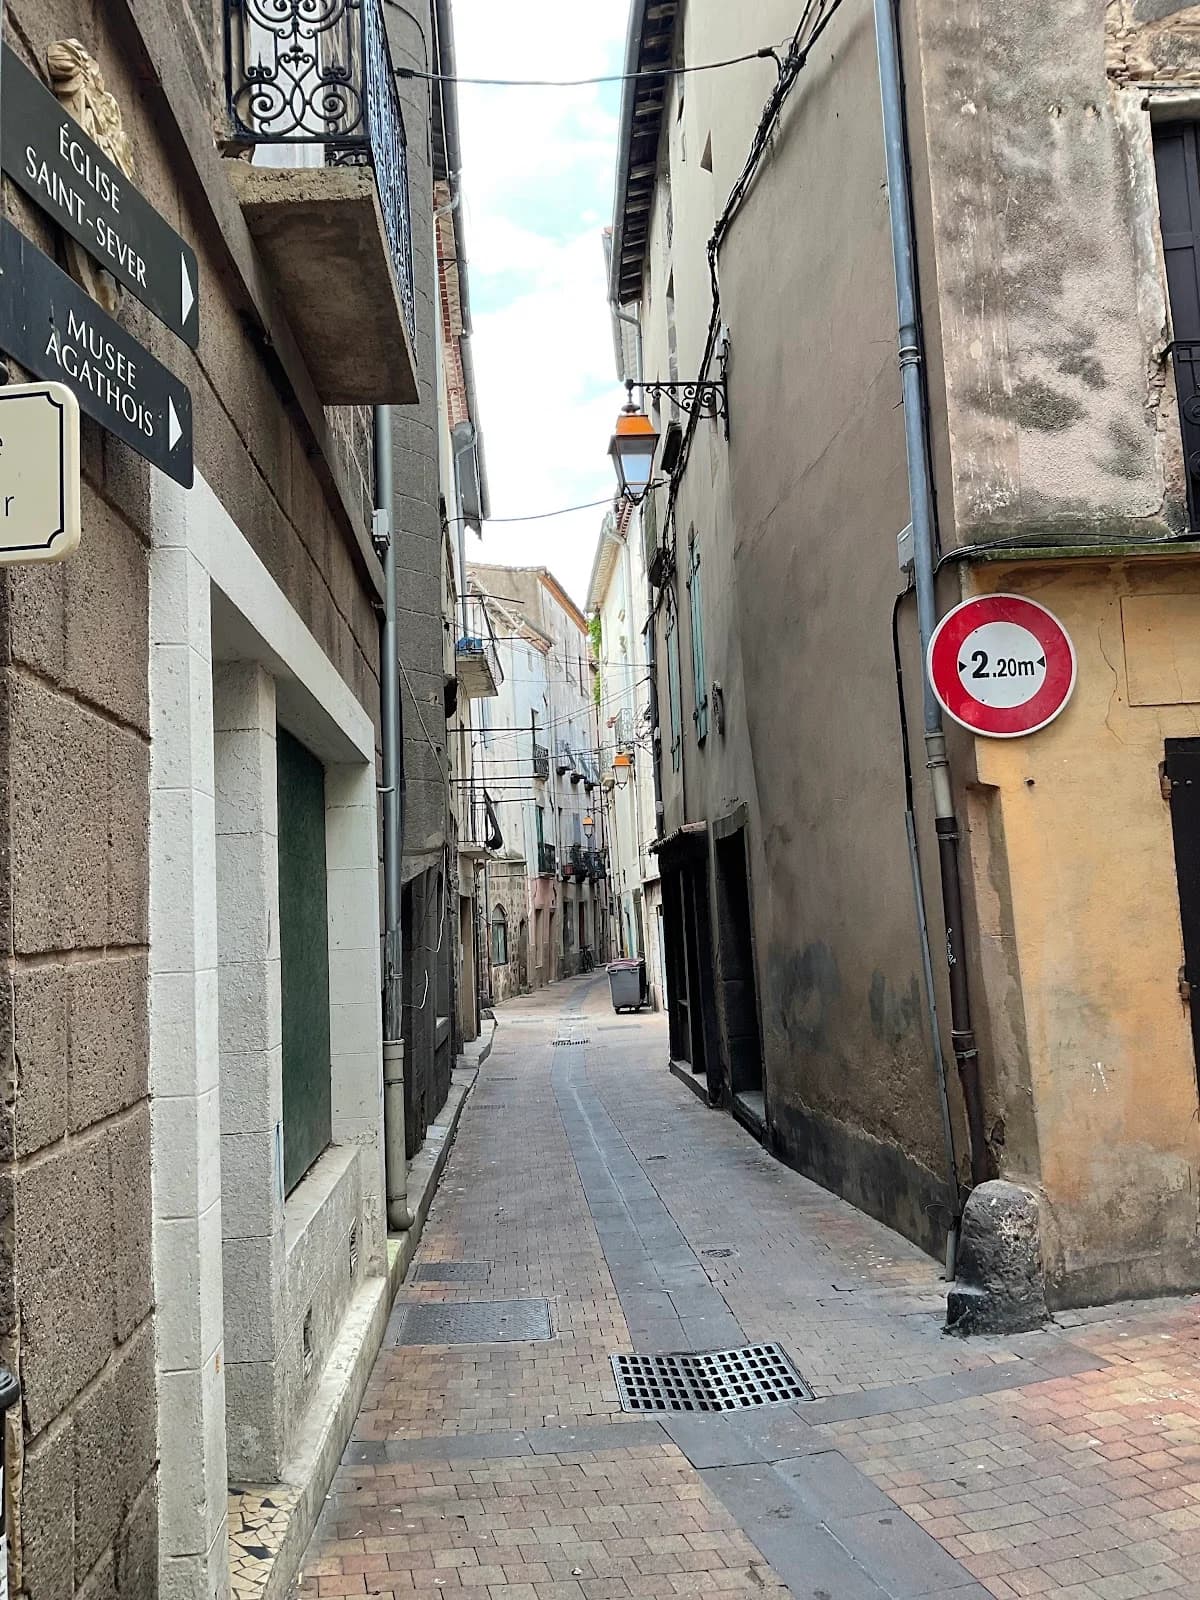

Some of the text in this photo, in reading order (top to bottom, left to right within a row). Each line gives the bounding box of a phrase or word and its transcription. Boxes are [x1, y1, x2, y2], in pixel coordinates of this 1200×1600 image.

[59, 122, 121, 214] ÉGLISE
[25, 145, 148, 289] SAINT-SEVER
[45, 332, 154, 437] AGATHOIS
[67, 308, 137, 391] MUSEE
[971, 650, 1035, 679] 2.20m
